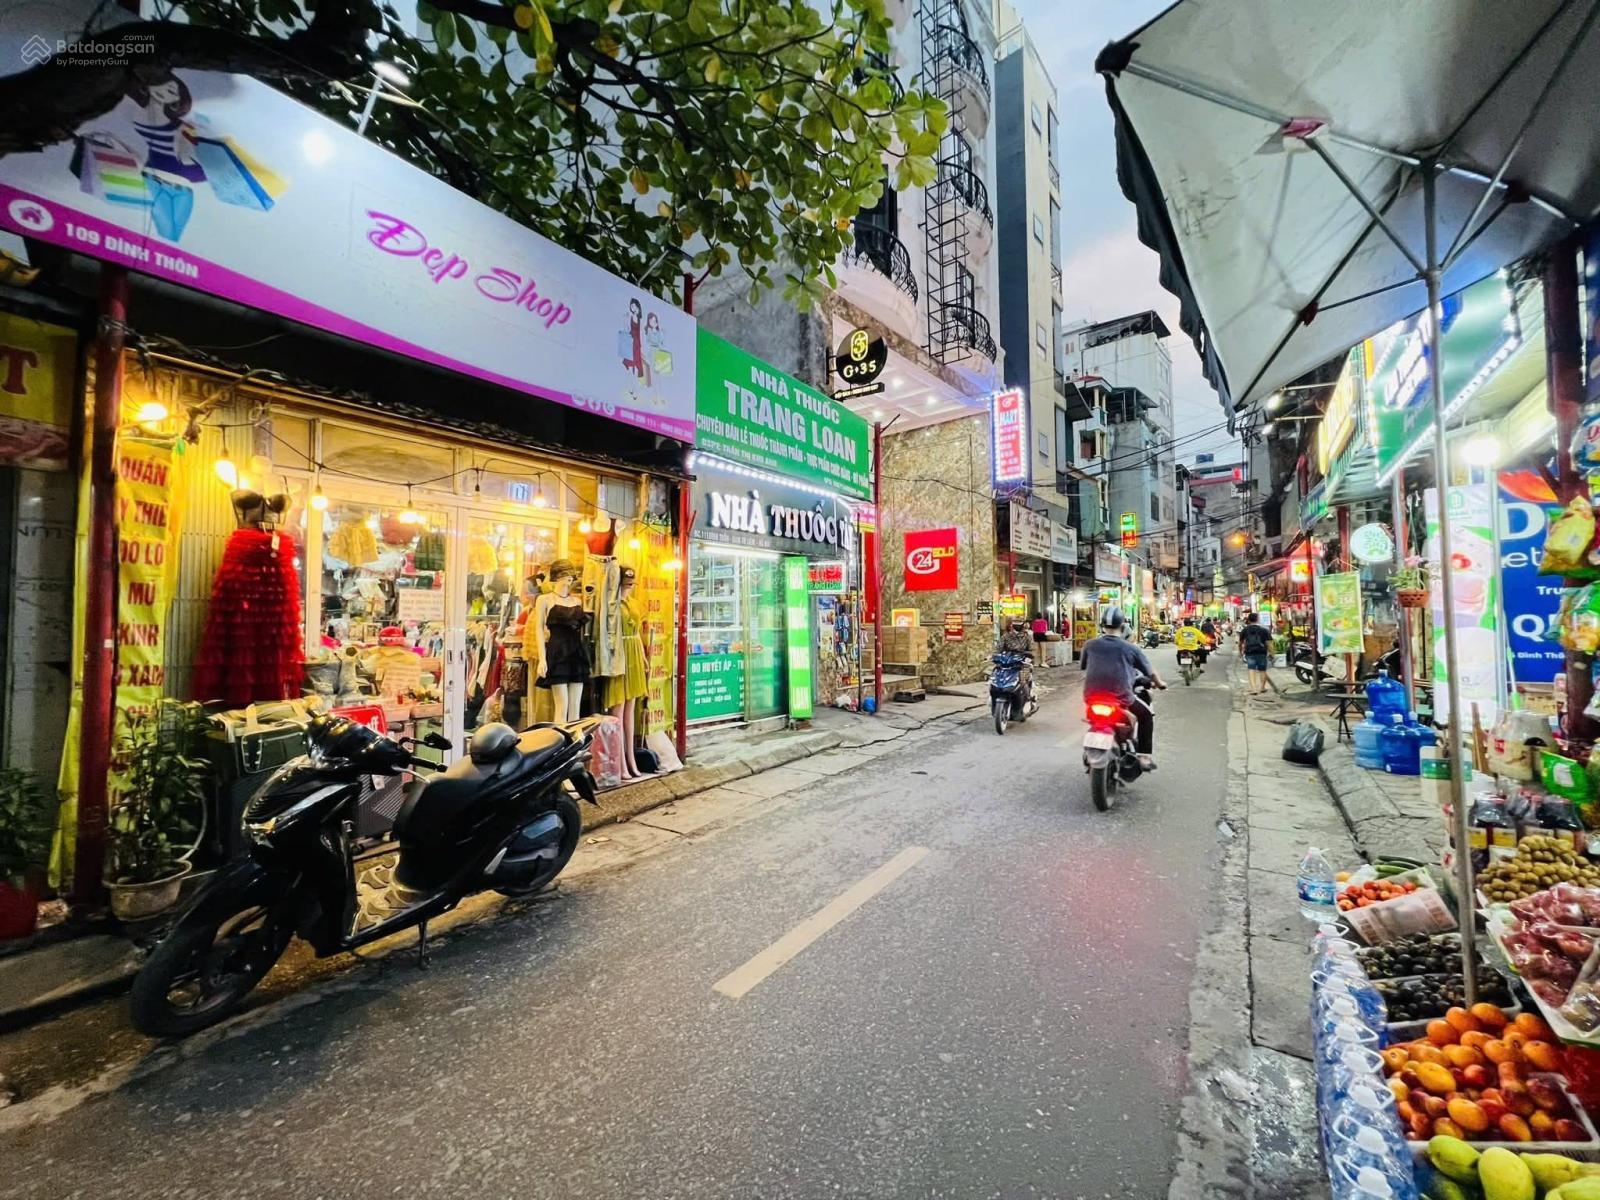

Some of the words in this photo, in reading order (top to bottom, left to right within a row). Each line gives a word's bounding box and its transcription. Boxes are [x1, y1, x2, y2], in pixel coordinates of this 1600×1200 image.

[65, 222, 100, 245] 109
[105, 233, 150, 263] ĐÌNH
[154, 251, 199, 278] THÔN
[365, 209, 469, 285] Đẹp
[475, 266, 573, 330] Shop
[724, 379, 806, 443] TRANG
[811, 420, 857, 465] LOAN
[751, 365, 790, 400] NHÀ
[793, 388, 841, 425] THUỐC
[710, 489, 767, 535] NHÀ
[771, 500, 837, 545] THUỐC
